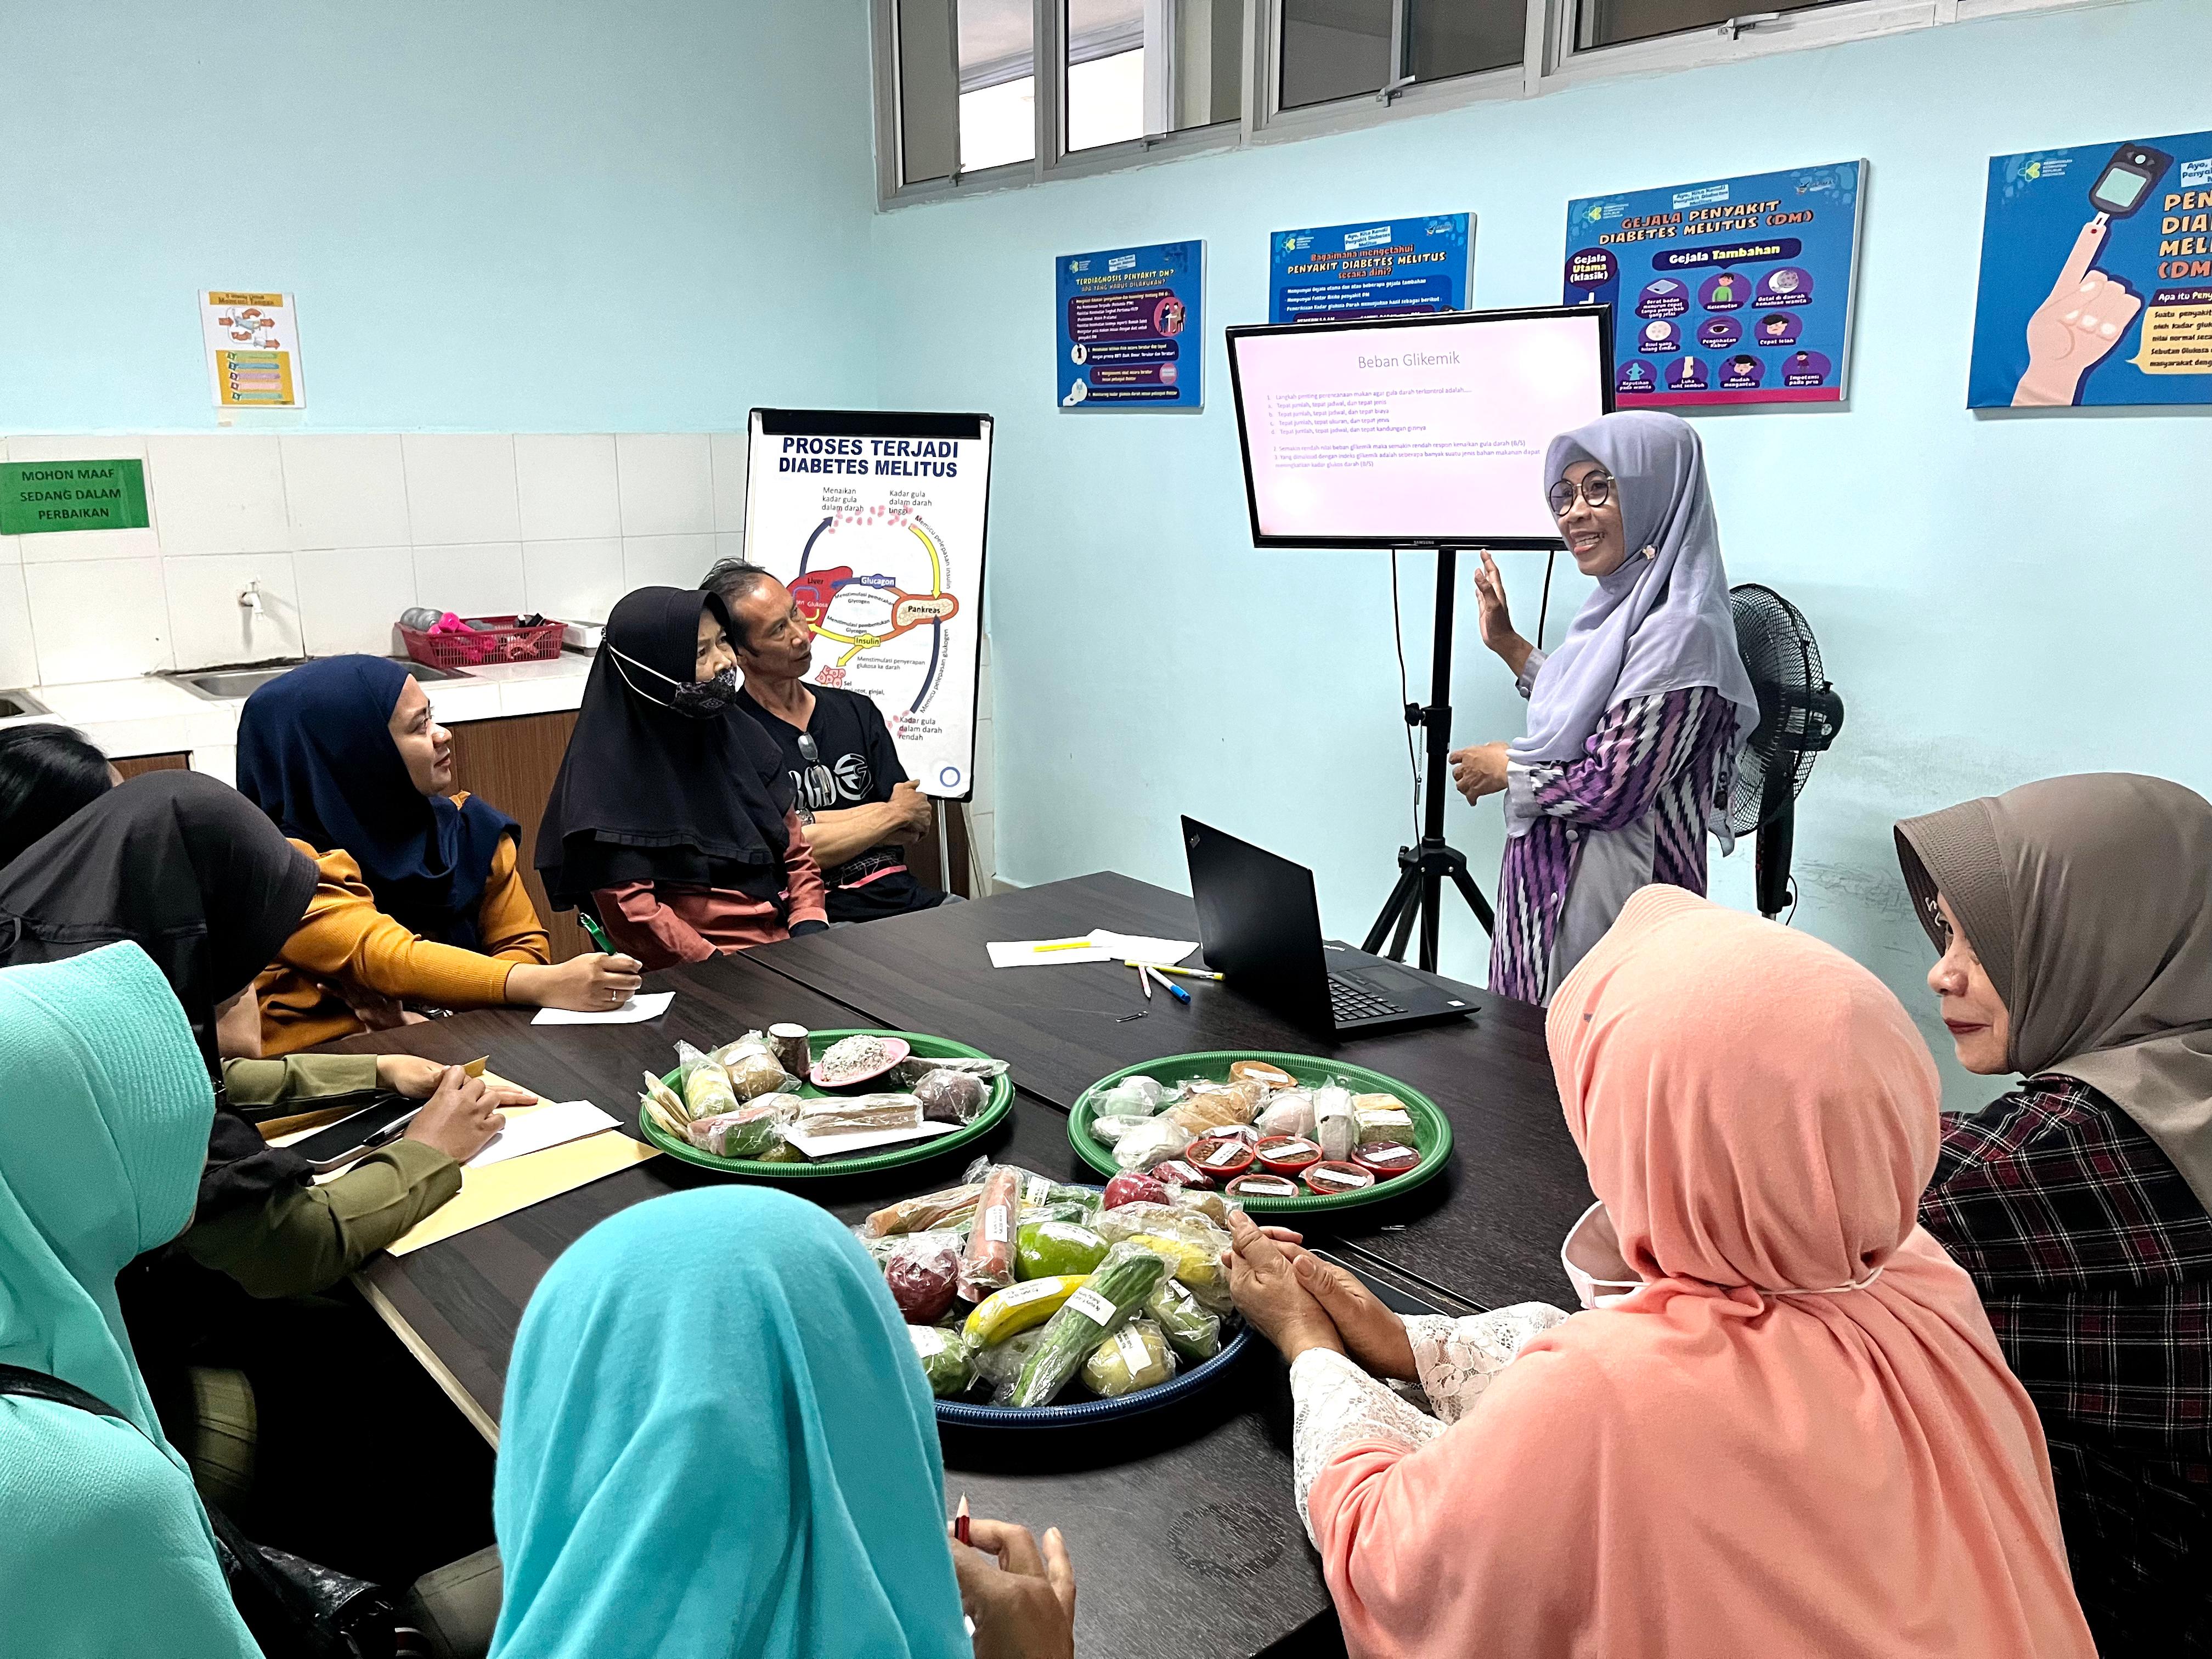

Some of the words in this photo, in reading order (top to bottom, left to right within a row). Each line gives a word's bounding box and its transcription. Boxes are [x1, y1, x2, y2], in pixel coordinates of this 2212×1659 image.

[1622, 212, 1682, 229] GEJALA
[1689, 200, 1781, 221] PENYAKIT
[1599, 226, 1676, 245] DIABETES
[1684, 217, 1757, 236] MELITUS
[1766, 210, 1813, 226] (DM)
[2162, 214, 2212, 234] DIA
[1311, 252, 1357, 262] Bagaimana
[1359, 244, 1414, 257] mengetahui
[2159, 237, 2212, 256] MEL
[1574, 254, 1606, 264] Gejala
[1669, 252, 1708, 264] Gejala
[1712, 246, 1780, 260] Tambahan
[1288, 262, 1338, 274] PENYAKIT
[1342, 257, 1393, 269] DIABETES
[1398, 252, 1446, 264] MELITUS
[1573, 264, 1606, 273] Utama
[1076, 275, 1122, 285] TERDIAGNOSIS
[1124, 271, 1156, 281] PENYAKIT
[1369, 267, 1392, 276] dini?
[1570, 272, 1608, 283] (klasik)
[2159, 294, 2175, 303] Apa
[1359, 355, 1398, 368] Beban
[1403, 351, 1460, 366] Glikemik
[783, 437, 862, 455] PROSES
[871, 441, 958, 458] TERJADI
[779, 457, 868, 475] DIABETES
[876, 460, 957, 477] MELITUS
[22, 470, 74, 481] MOHON
[78, 469, 115, 479] MAAF
[20, 490, 72, 502] SEDANG
[75, 489, 121, 500] DALAM
[911, 490, 926, 499] gula
[38, 509, 109, 520] PERBAIKAN
[889, 507, 908, 515] tinggi
[915, 515, 935, 535] Memicu
[934, 535, 950, 566] pelepasan
[861, 577, 894, 586] Glucagon
[908, 605, 940, 614] Pankreas
[920, 690, 936, 713] Memicu
[934, 659, 946, 690] pelepasan
[900, 716, 919, 724] Kadar
[921, 717, 936, 726] gula
[922, 726, 943, 734] darah
